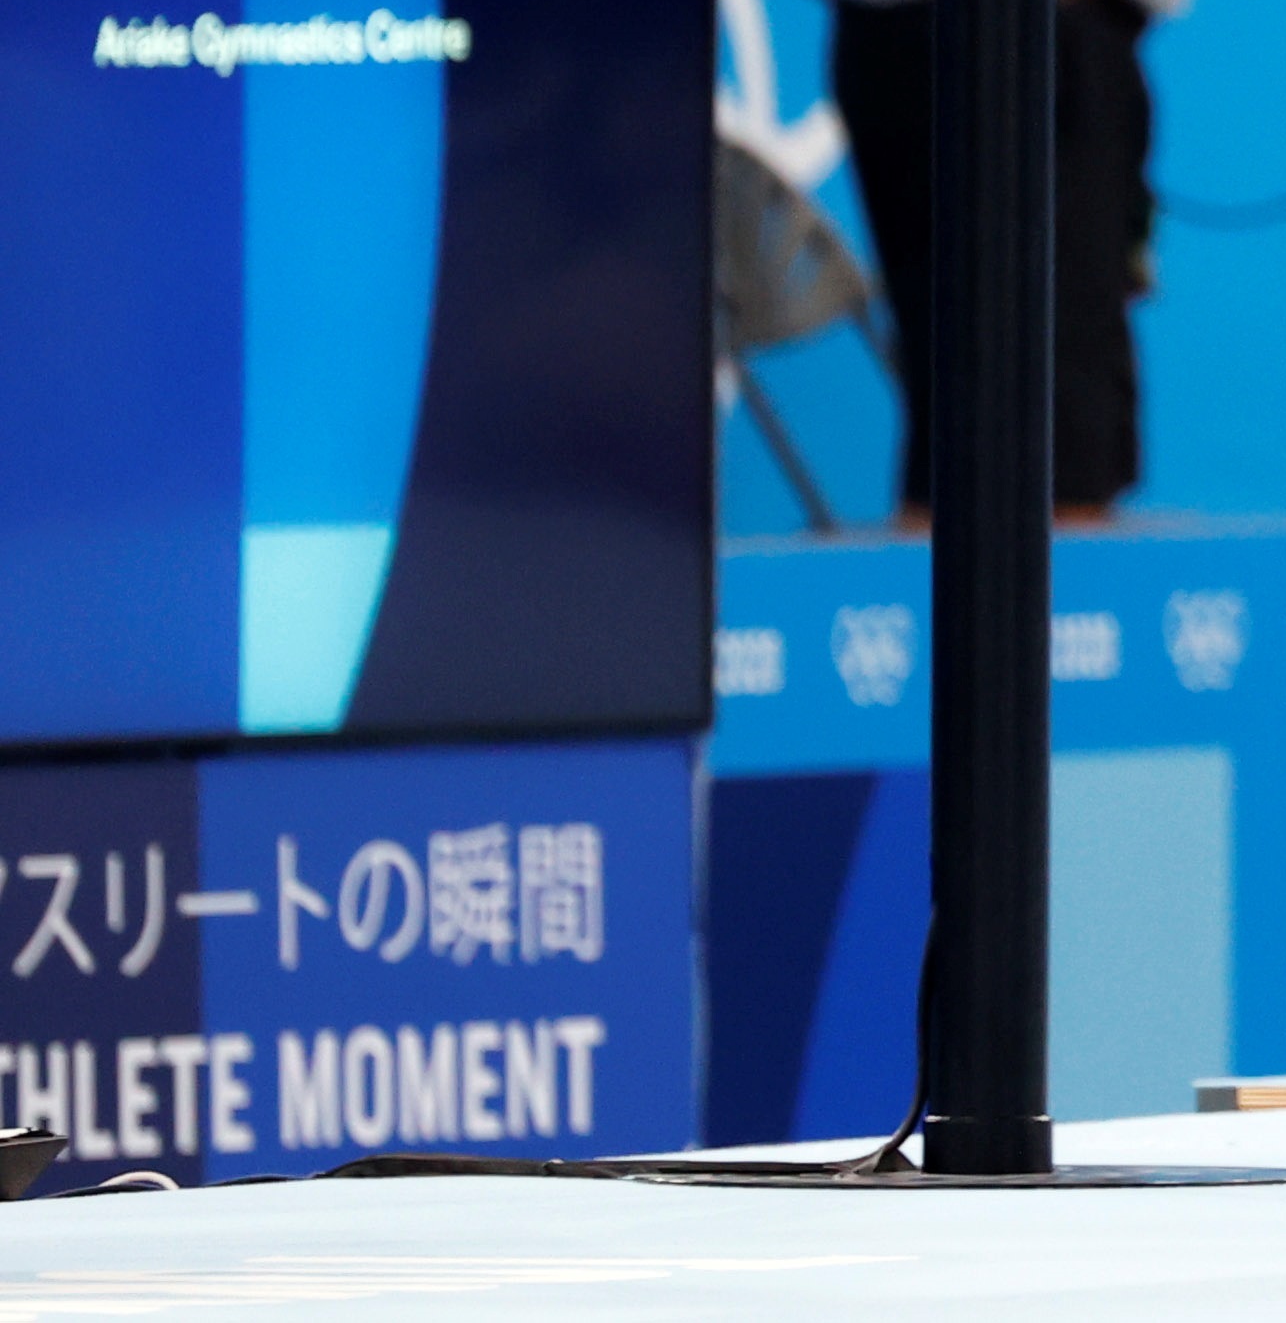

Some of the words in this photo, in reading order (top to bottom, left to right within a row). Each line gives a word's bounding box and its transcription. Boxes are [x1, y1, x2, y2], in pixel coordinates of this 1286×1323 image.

[0, 823, 604, 977] スリートの瞬間
[278, 1016, 604, 1149] MOMENT
